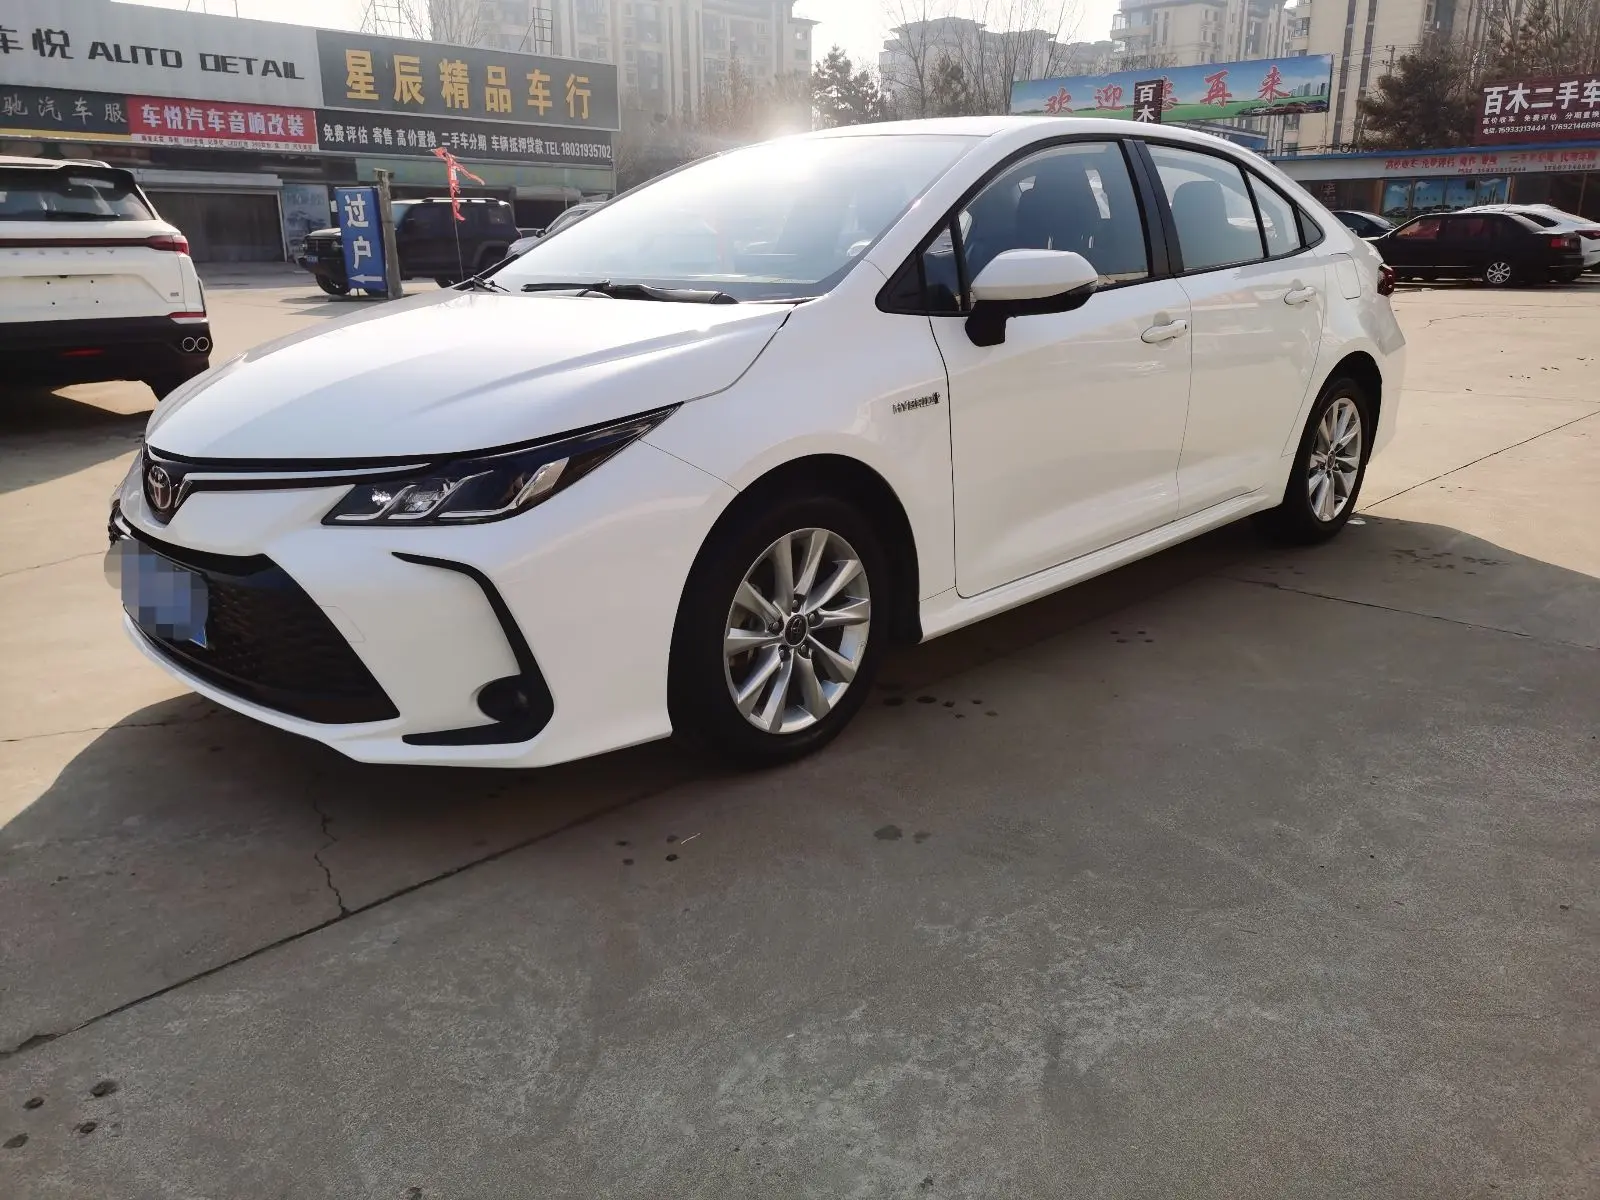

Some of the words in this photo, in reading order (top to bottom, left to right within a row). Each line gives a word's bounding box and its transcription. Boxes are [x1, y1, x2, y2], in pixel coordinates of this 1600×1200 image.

[88, 41, 183, 69] AUTO
[199, 52, 305, 80] DETAIL
[345, 48, 592, 120] 星辰精品车行
[1136, 83, 1157, 123] 百木
[1483, 79, 1600, 116] 百木二手车
[2, 93, 128, 125] 驰汽车服
[141, 103, 304, 137] 车悦汽车音响改装
[323, 123, 369, 144] 免费评估
[372, 126, 393, 146] 寄售
[395, 128, 437, 148] 高价置换
[441, 132, 487, 151] 二手车分期
[561, 143, 612, 159] 18031935702
[344, 193, 372, 270] 过户
